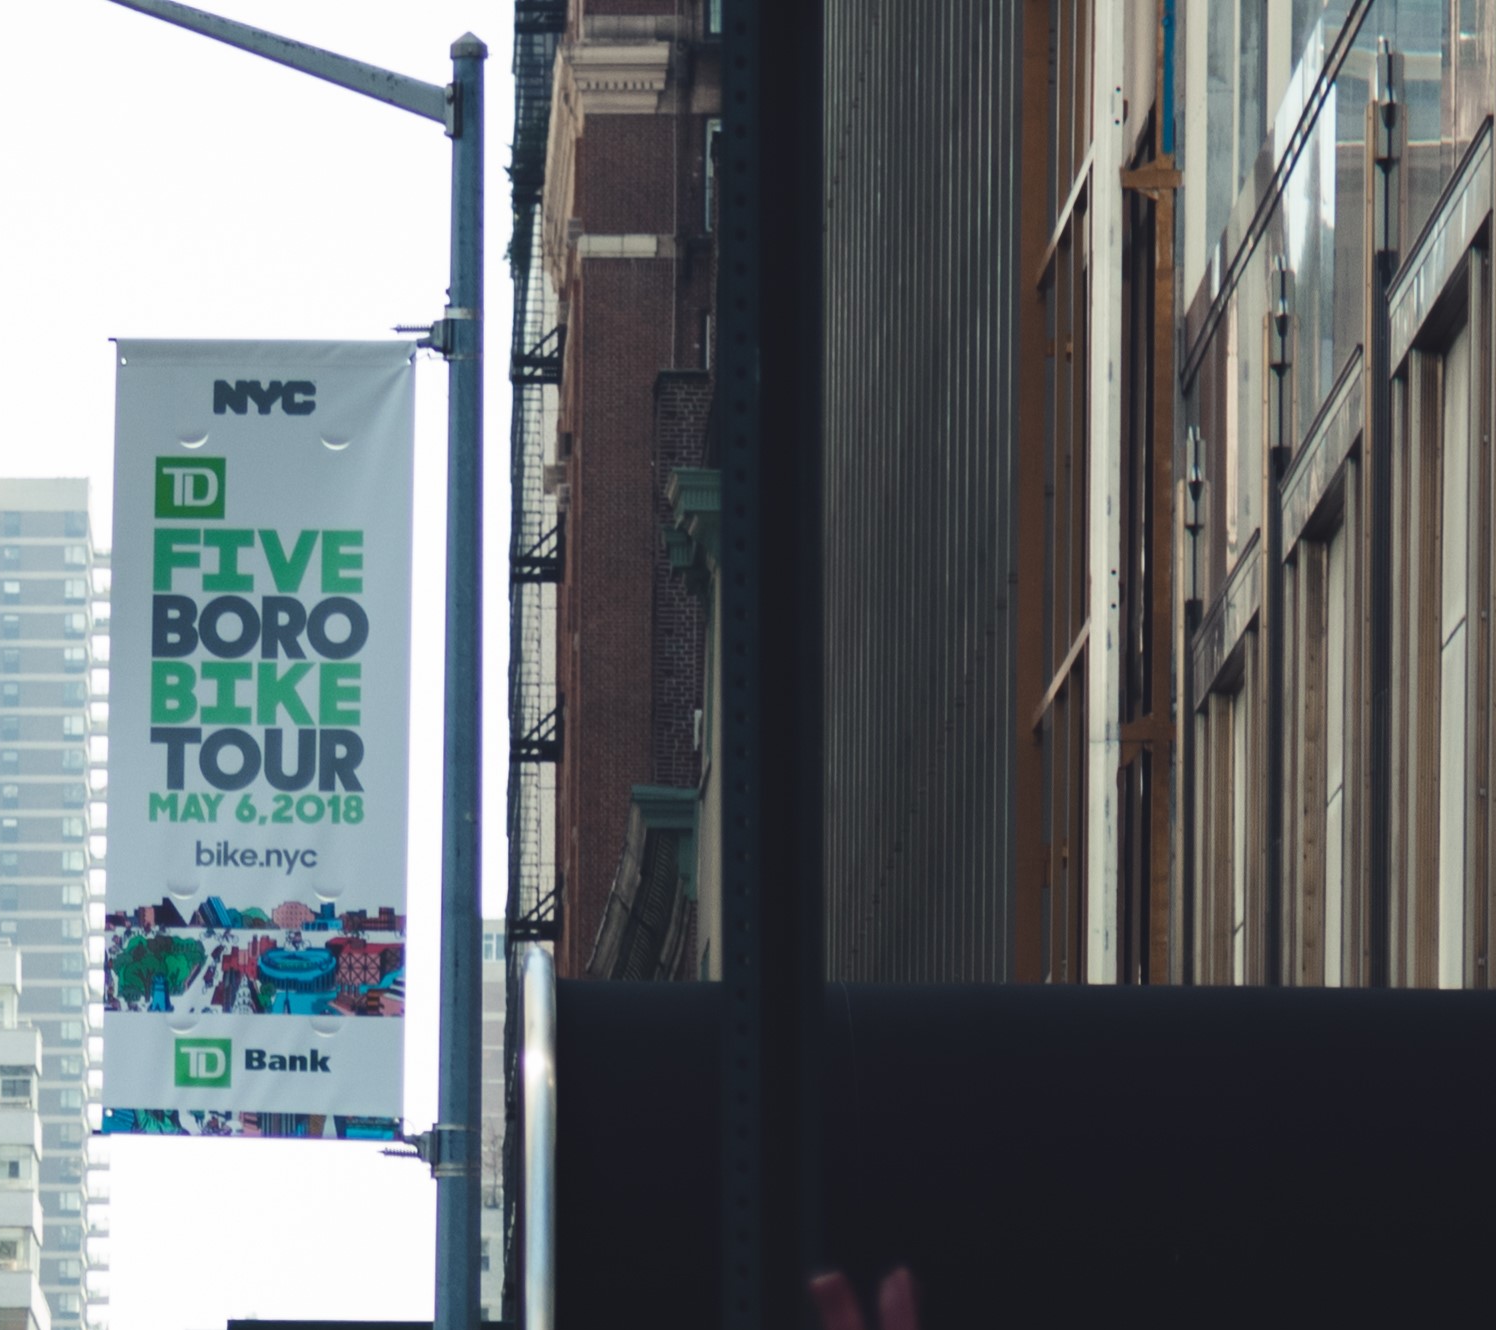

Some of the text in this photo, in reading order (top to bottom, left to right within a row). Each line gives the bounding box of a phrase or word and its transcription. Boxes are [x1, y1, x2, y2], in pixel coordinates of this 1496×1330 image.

[212, 379, 317, 416] NYC
[162, 466, 219, 509] TD
[153, 528, 364, 594] FIVE
[151, 595, 369, 660] BORO
[150, 661, 362, 727] BIKE
[150, 727, 365, 792] TOUR
[148, 792, 225, 825] MAY
[195, 839, 319, 874] bike.nyc
[180, 1044, 332, 1080] TD Bank
